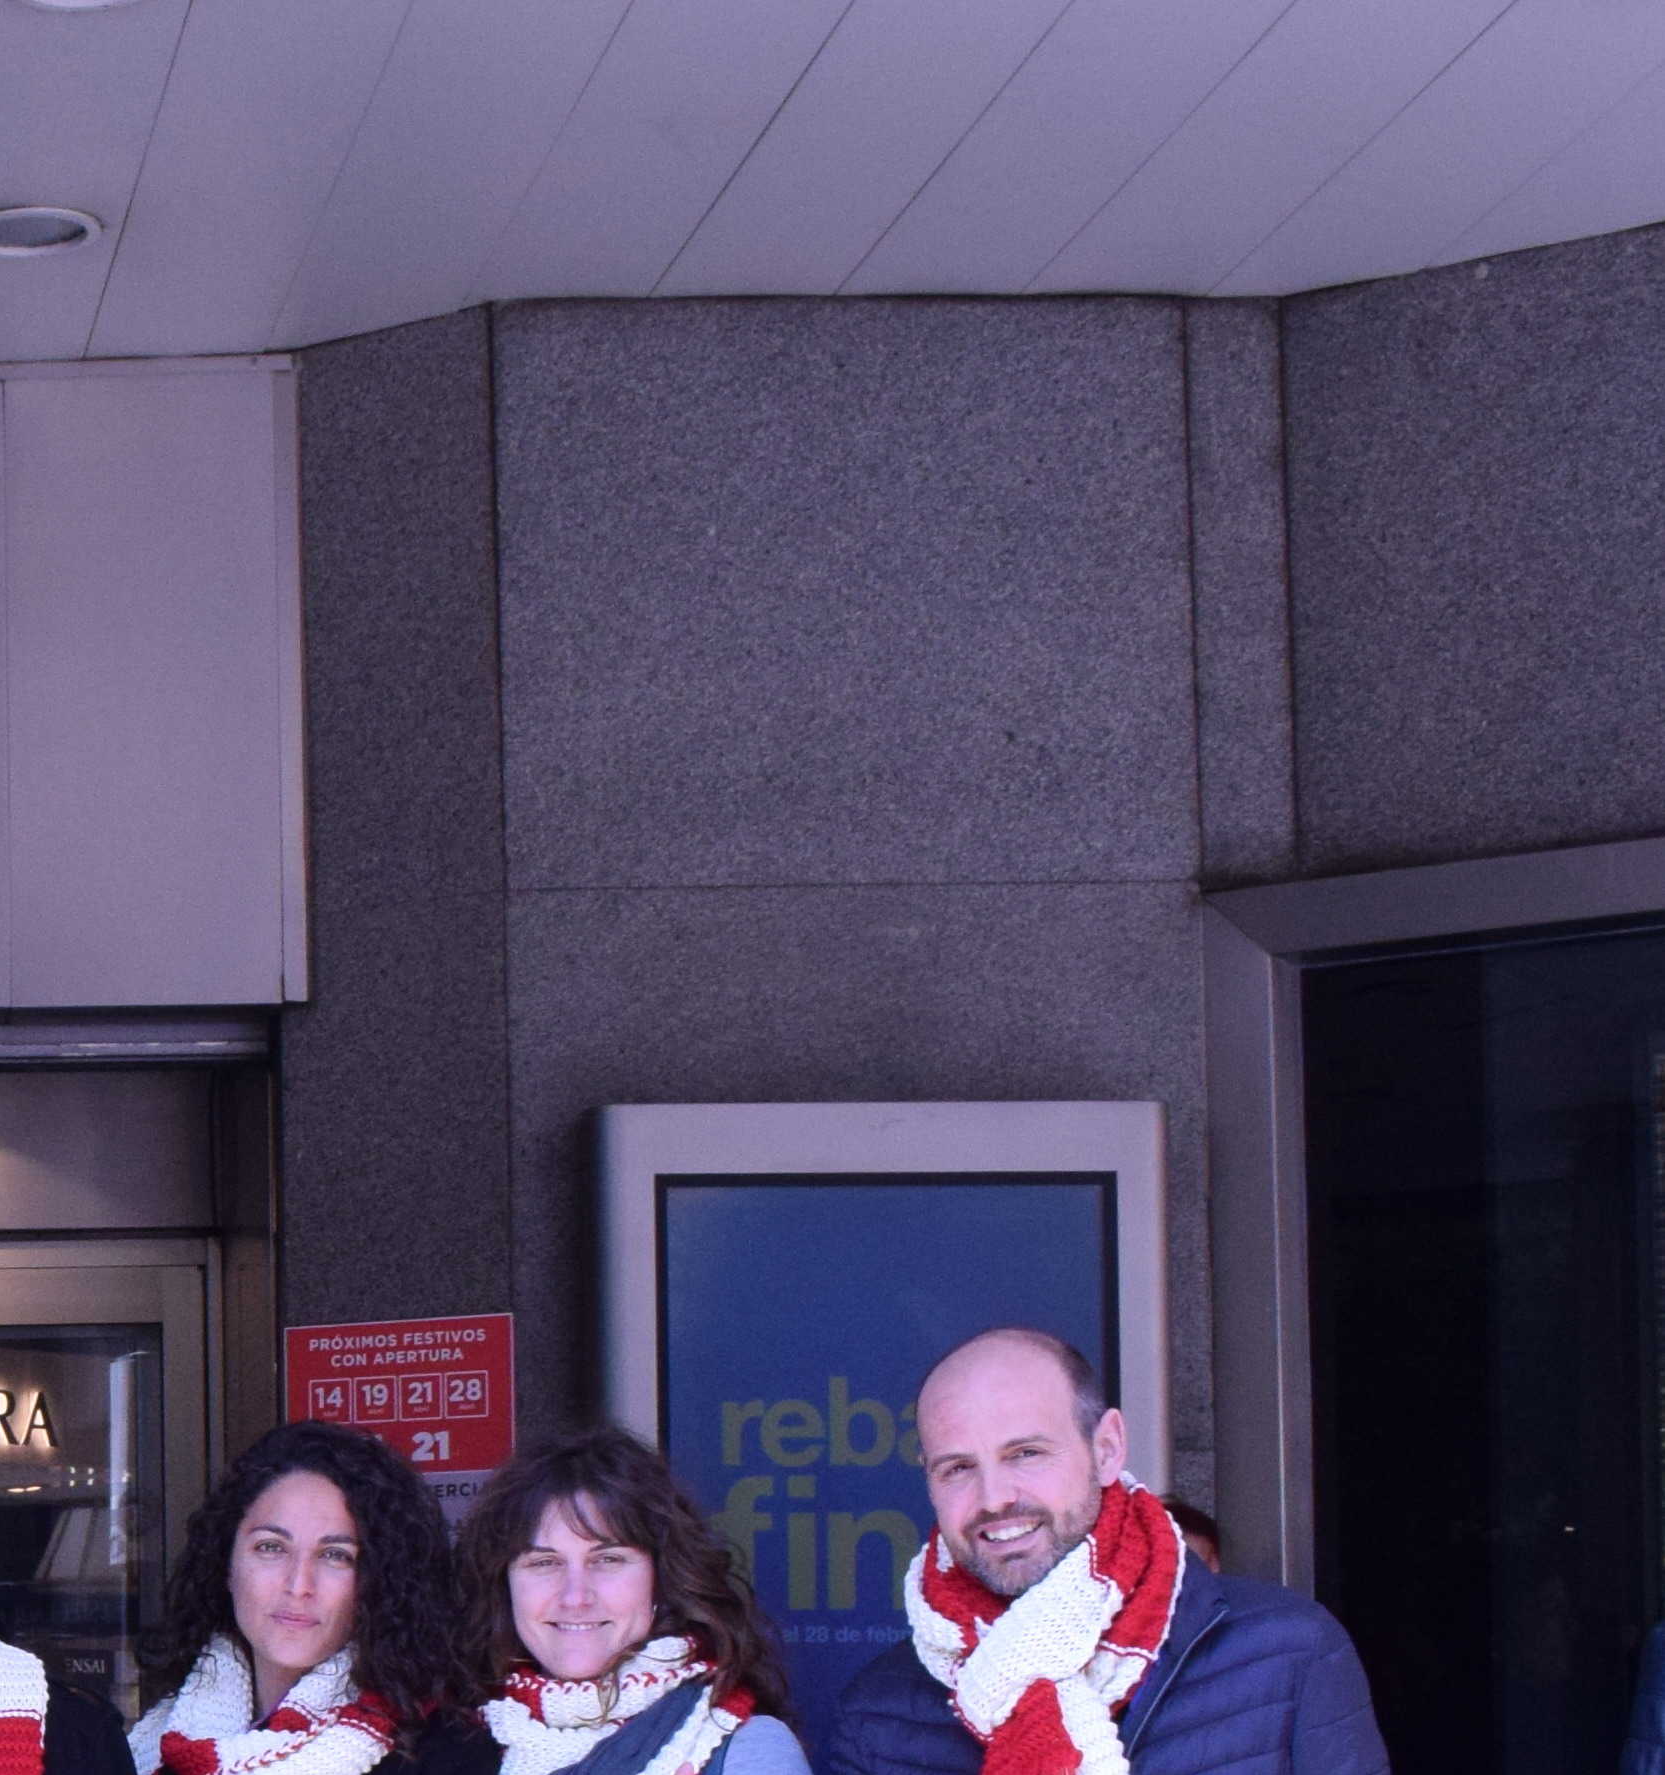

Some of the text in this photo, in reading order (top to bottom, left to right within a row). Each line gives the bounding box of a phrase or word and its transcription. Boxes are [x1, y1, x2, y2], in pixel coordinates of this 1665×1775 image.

[309, 1328, 487, 1352] PRÓXIMOS FESTIVOS
[330, 1348, 465, 1368] CON APERTURA
[315, 1378, 482, 1409] 14 19 21 28
[411, 1430, 450, 1462] 21
